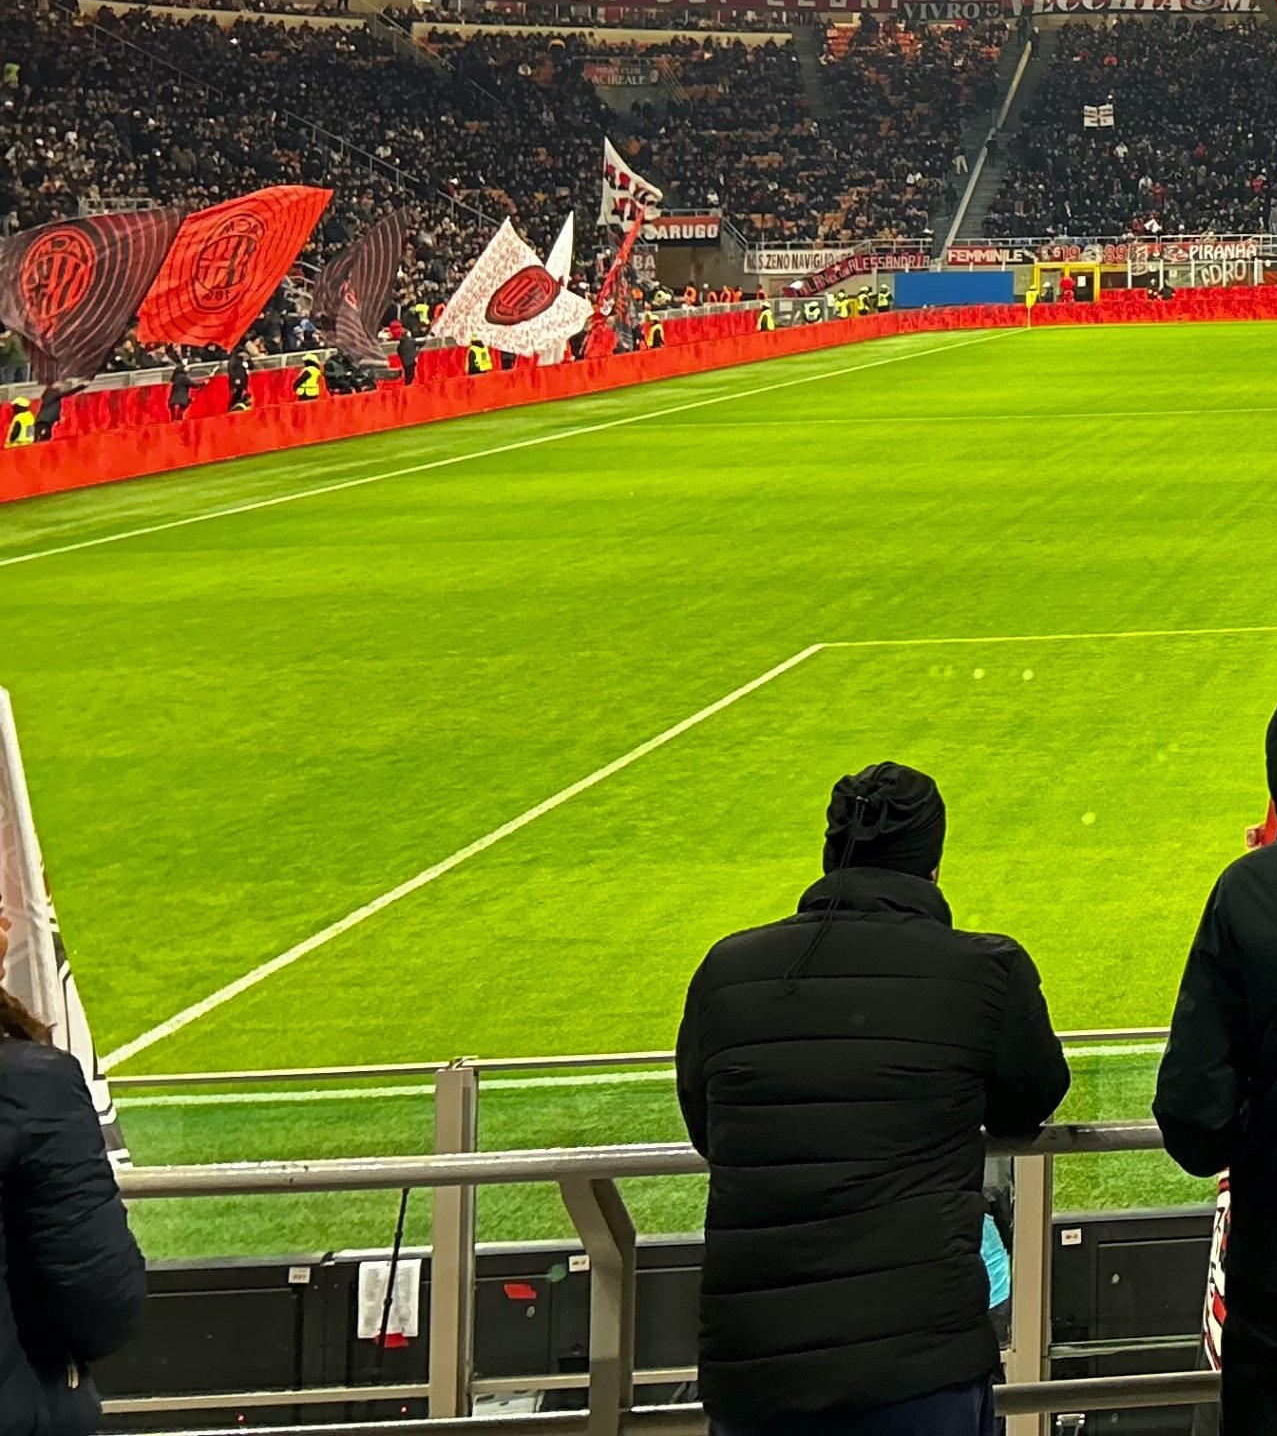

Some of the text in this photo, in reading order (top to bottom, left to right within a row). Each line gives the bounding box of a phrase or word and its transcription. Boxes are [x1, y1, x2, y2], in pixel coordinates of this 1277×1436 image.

[948, 248, 1024, 263] FEMMINILE
[1189, 244, 1257, 260] PIRANHA
[848, 251, 931, 272] ALESSANDRIA
